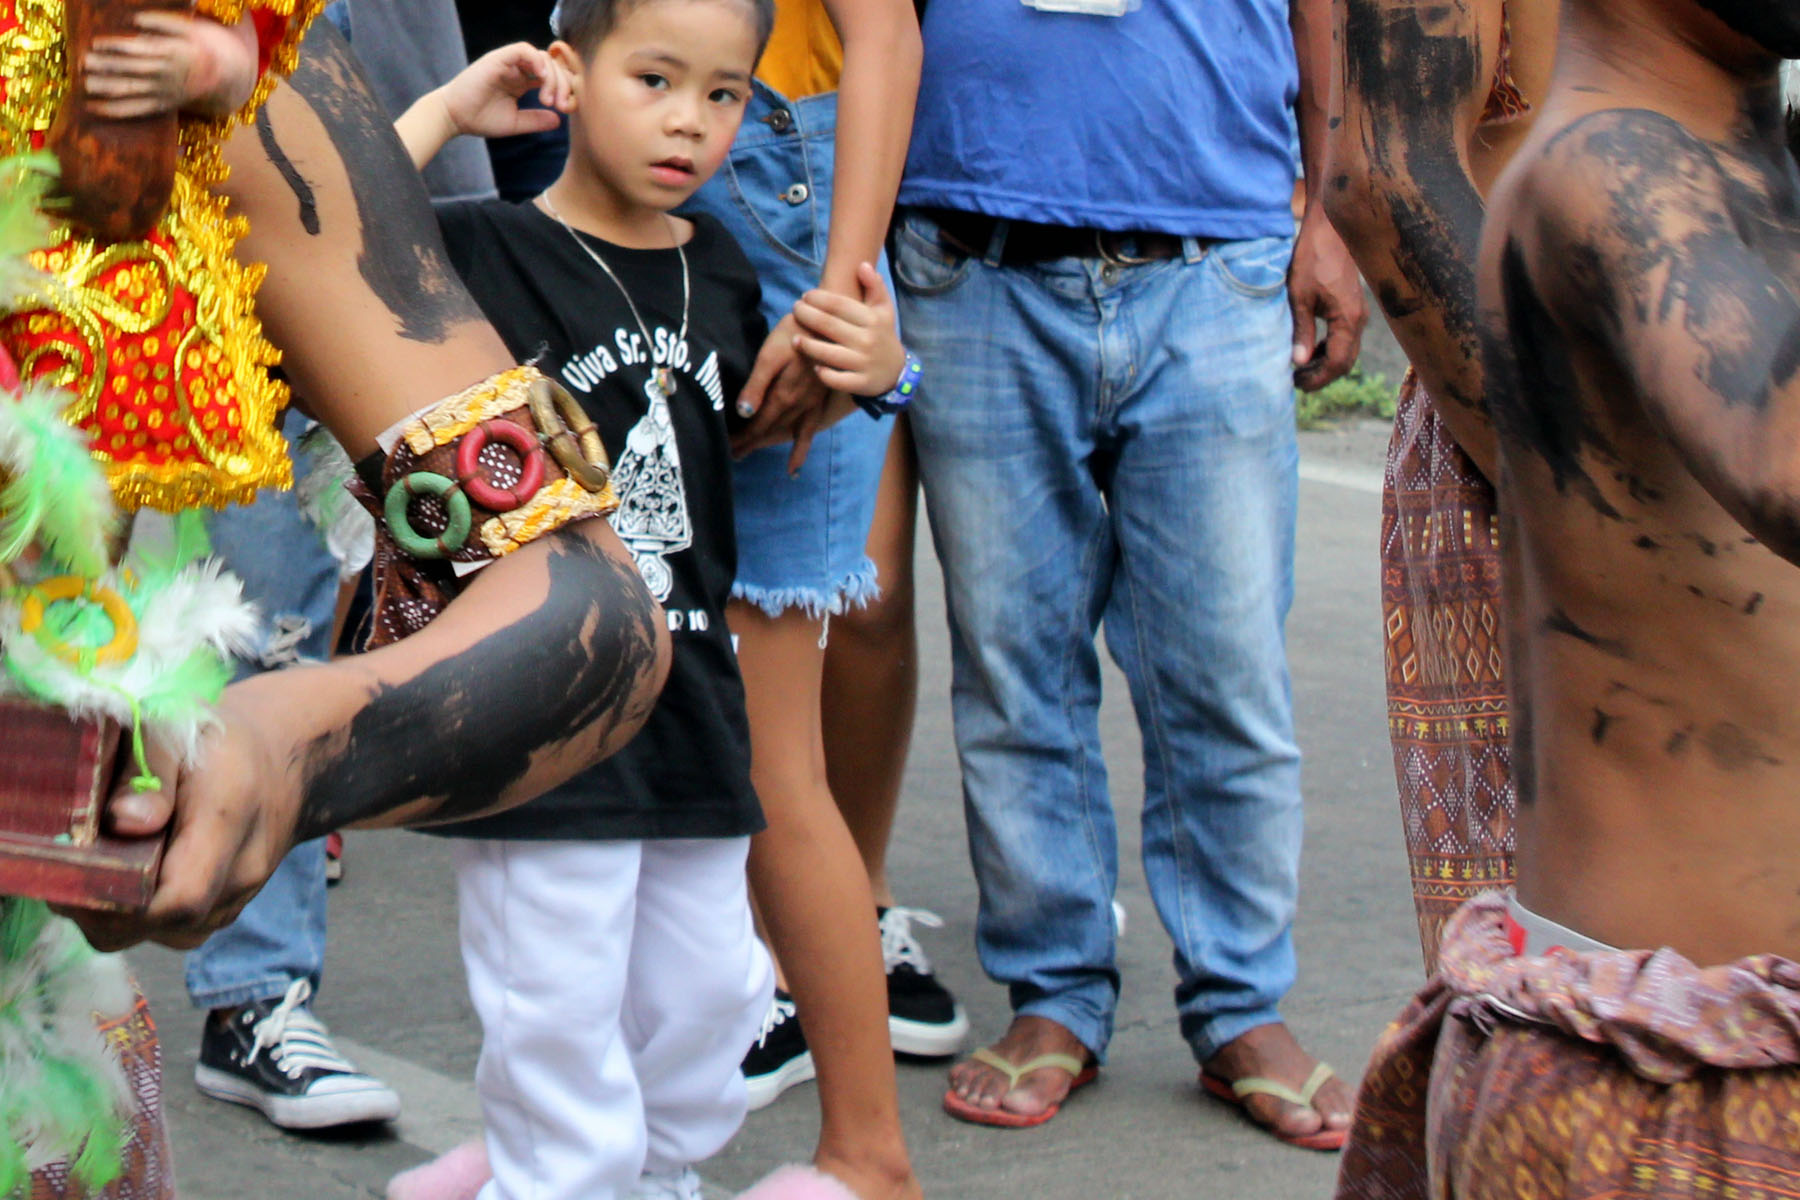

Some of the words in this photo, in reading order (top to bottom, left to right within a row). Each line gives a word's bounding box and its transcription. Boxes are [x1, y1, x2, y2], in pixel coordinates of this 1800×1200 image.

[561, 344, 618, 393] Viva
[614, 327, 647, 366] Sr.
[652, 326, 692, 373] Sto.
[688, 609, 709, 632] 10
